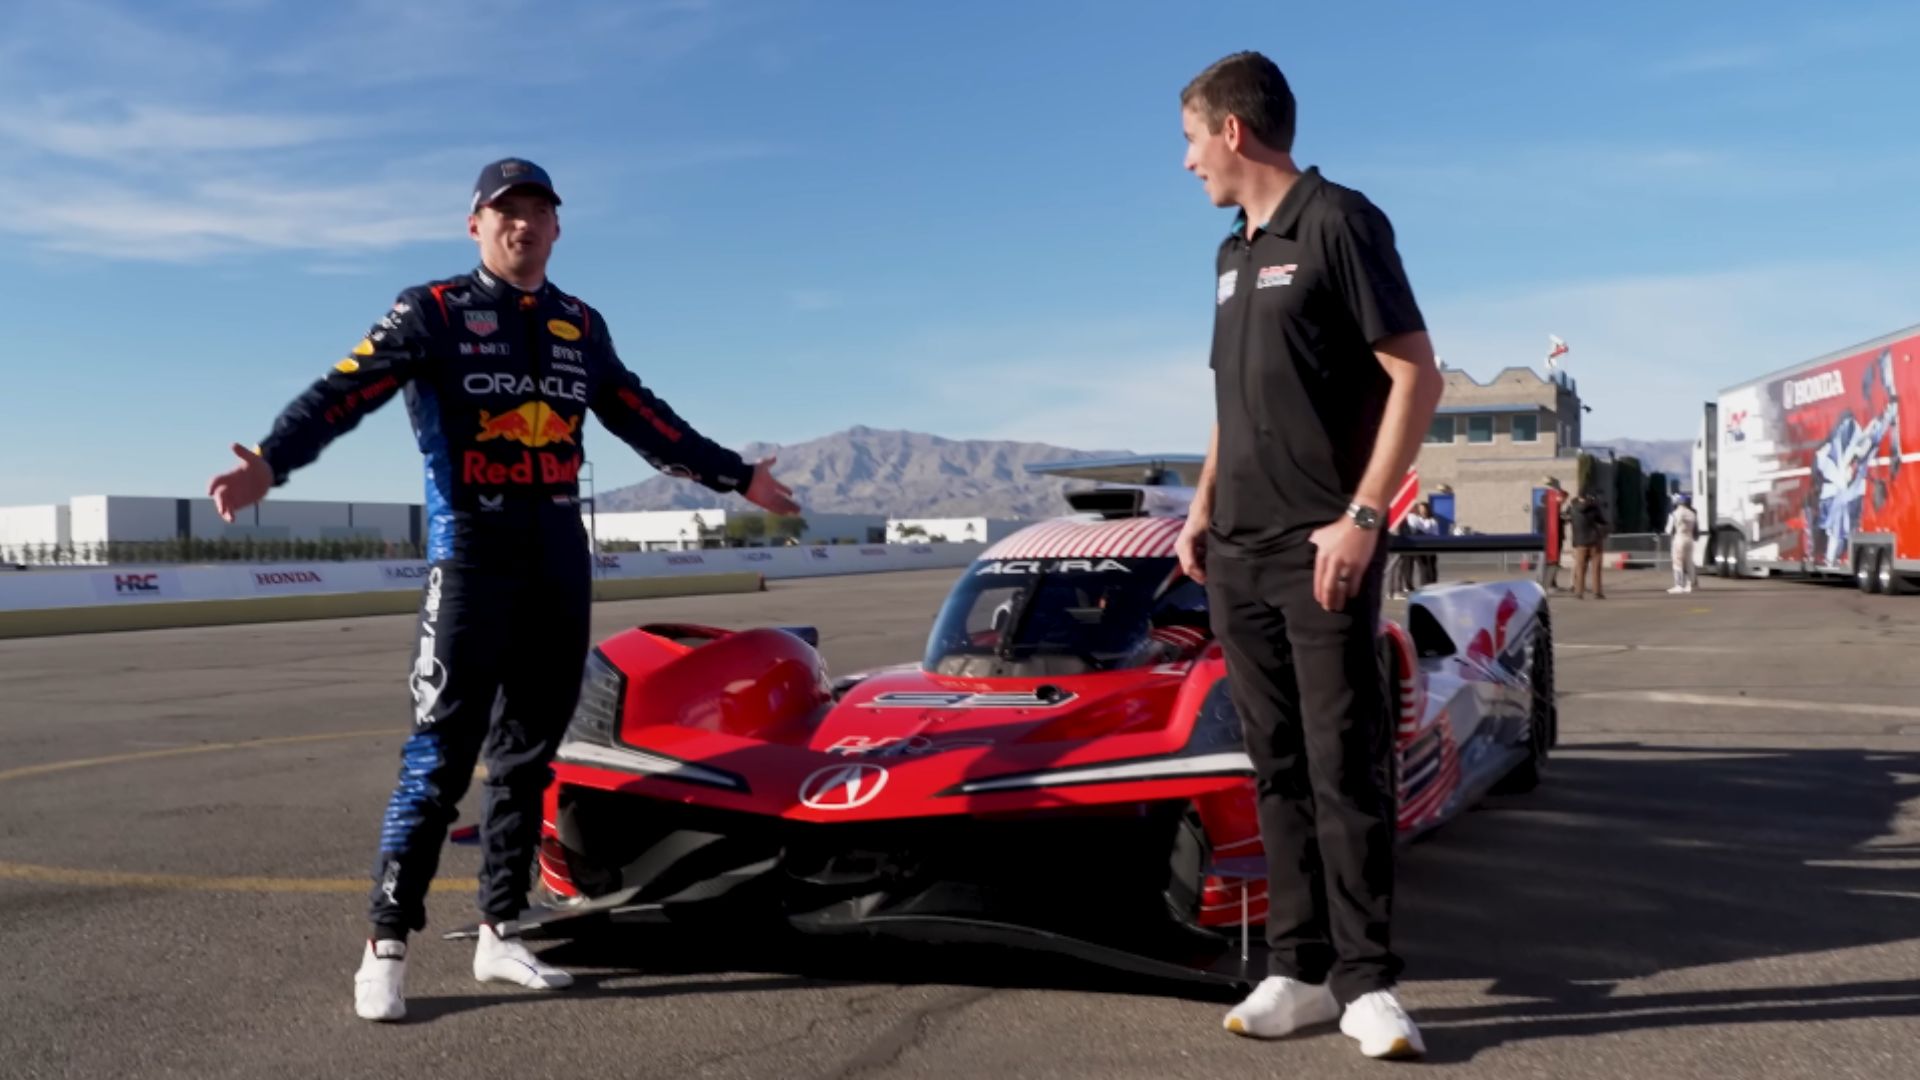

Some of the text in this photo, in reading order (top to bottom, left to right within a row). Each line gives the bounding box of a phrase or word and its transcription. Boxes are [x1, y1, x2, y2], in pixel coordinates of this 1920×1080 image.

[463, 373, 587, 402] ORACLE
[463, 450, 580, 484] Red Bul
[395, 566, 429, 578] ACUR
[976, 559, 1132, 576] ACURA
[114, 574, 160, 591] HRC
[255, 570, 322, 585] HONDA
